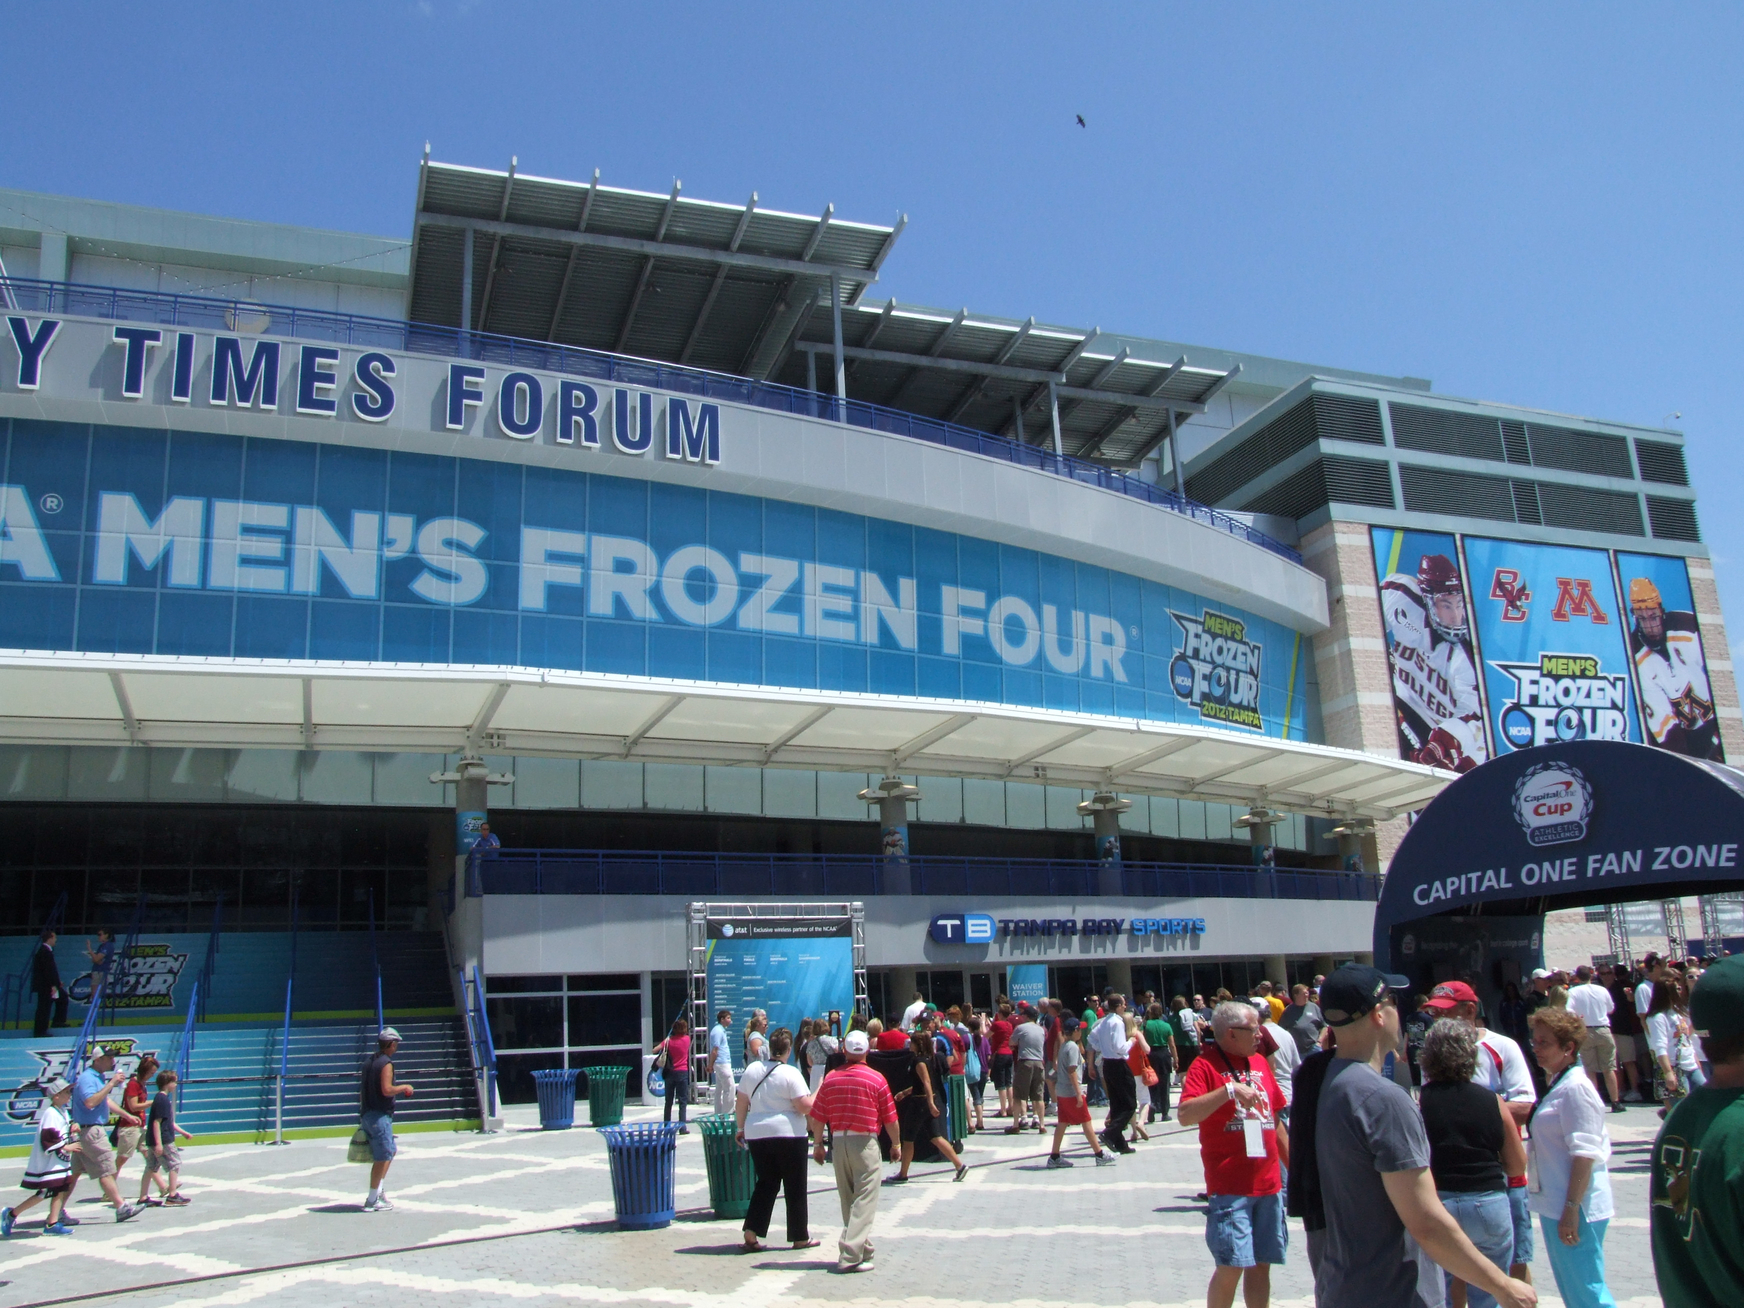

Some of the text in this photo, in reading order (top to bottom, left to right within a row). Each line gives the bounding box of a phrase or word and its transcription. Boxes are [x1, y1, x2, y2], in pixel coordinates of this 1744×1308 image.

[113, 325, 397, 423] TIMES
[446, 363, 721, 466] FORUM
[93, 490, 491, 606] MEN'S
[518, 525, 918, 652] FROZEN
[940, 583, 1130, 684] FOUR
[1550, 577, 1608, 625] M
[1204, 614, 1244, 641] MEN'S
[1181, 620, 1260, 676] FROZEN
[1175, 658, 1259, 709] NCAA FOUR
[1542, 657, 1597, 677] MEN'S
[1506, 668, 1623, 709] FROZEN
[1509, 706, 1625, 746] NCAA FOUR
[1532, 802, 1573, 817] Cup
[1534, 823, 1579, 836] ATHLETIC
[1534, 830, 1580, 842] EXCELLENCE
[1413, 844, 1739, 906] CAPITAL ONE FAN ZONE
[793, 926, 808, 934] partner
[937, 918, 1206, 937] TB TAMPA BAY SPORTS
[15, 1100, 38, 1109] NCAA
